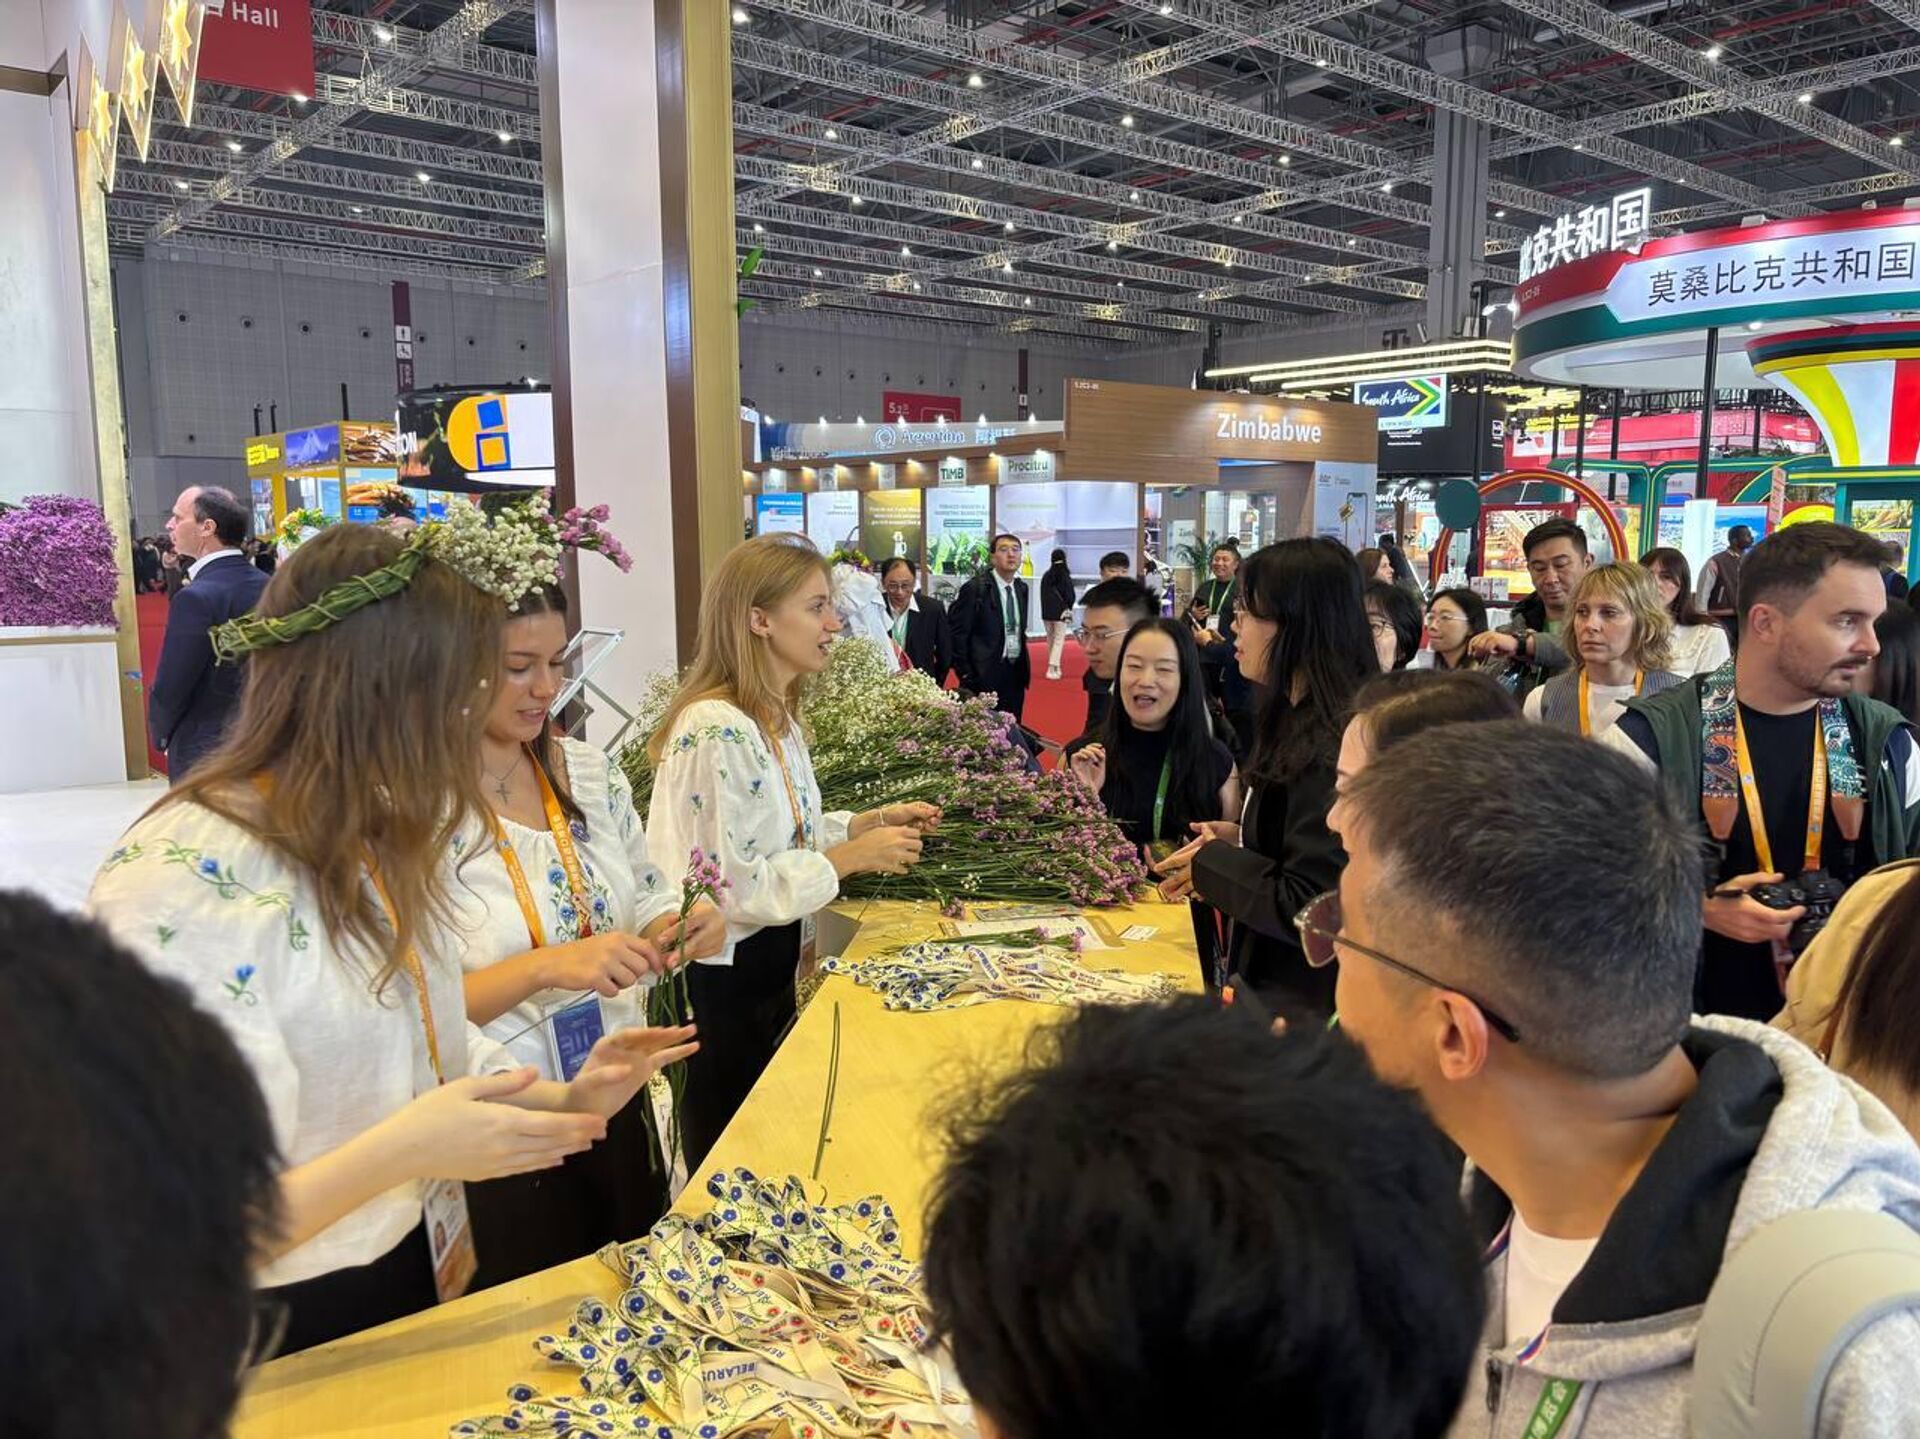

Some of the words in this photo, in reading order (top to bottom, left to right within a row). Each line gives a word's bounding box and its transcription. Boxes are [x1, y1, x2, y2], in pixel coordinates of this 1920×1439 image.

[232, 1, 278, 28] Hall
[1648, 241, 1916, 306] 莫桑比克共和国
[1361, 391, 1389, 406] South
[1391, 388, 1420, 406] Africa
[1217, 413, 1322, 443] Zimbabwe
[940, 468, 964, 480] TIMB
[1398, 486, 1430, 502] Africa
